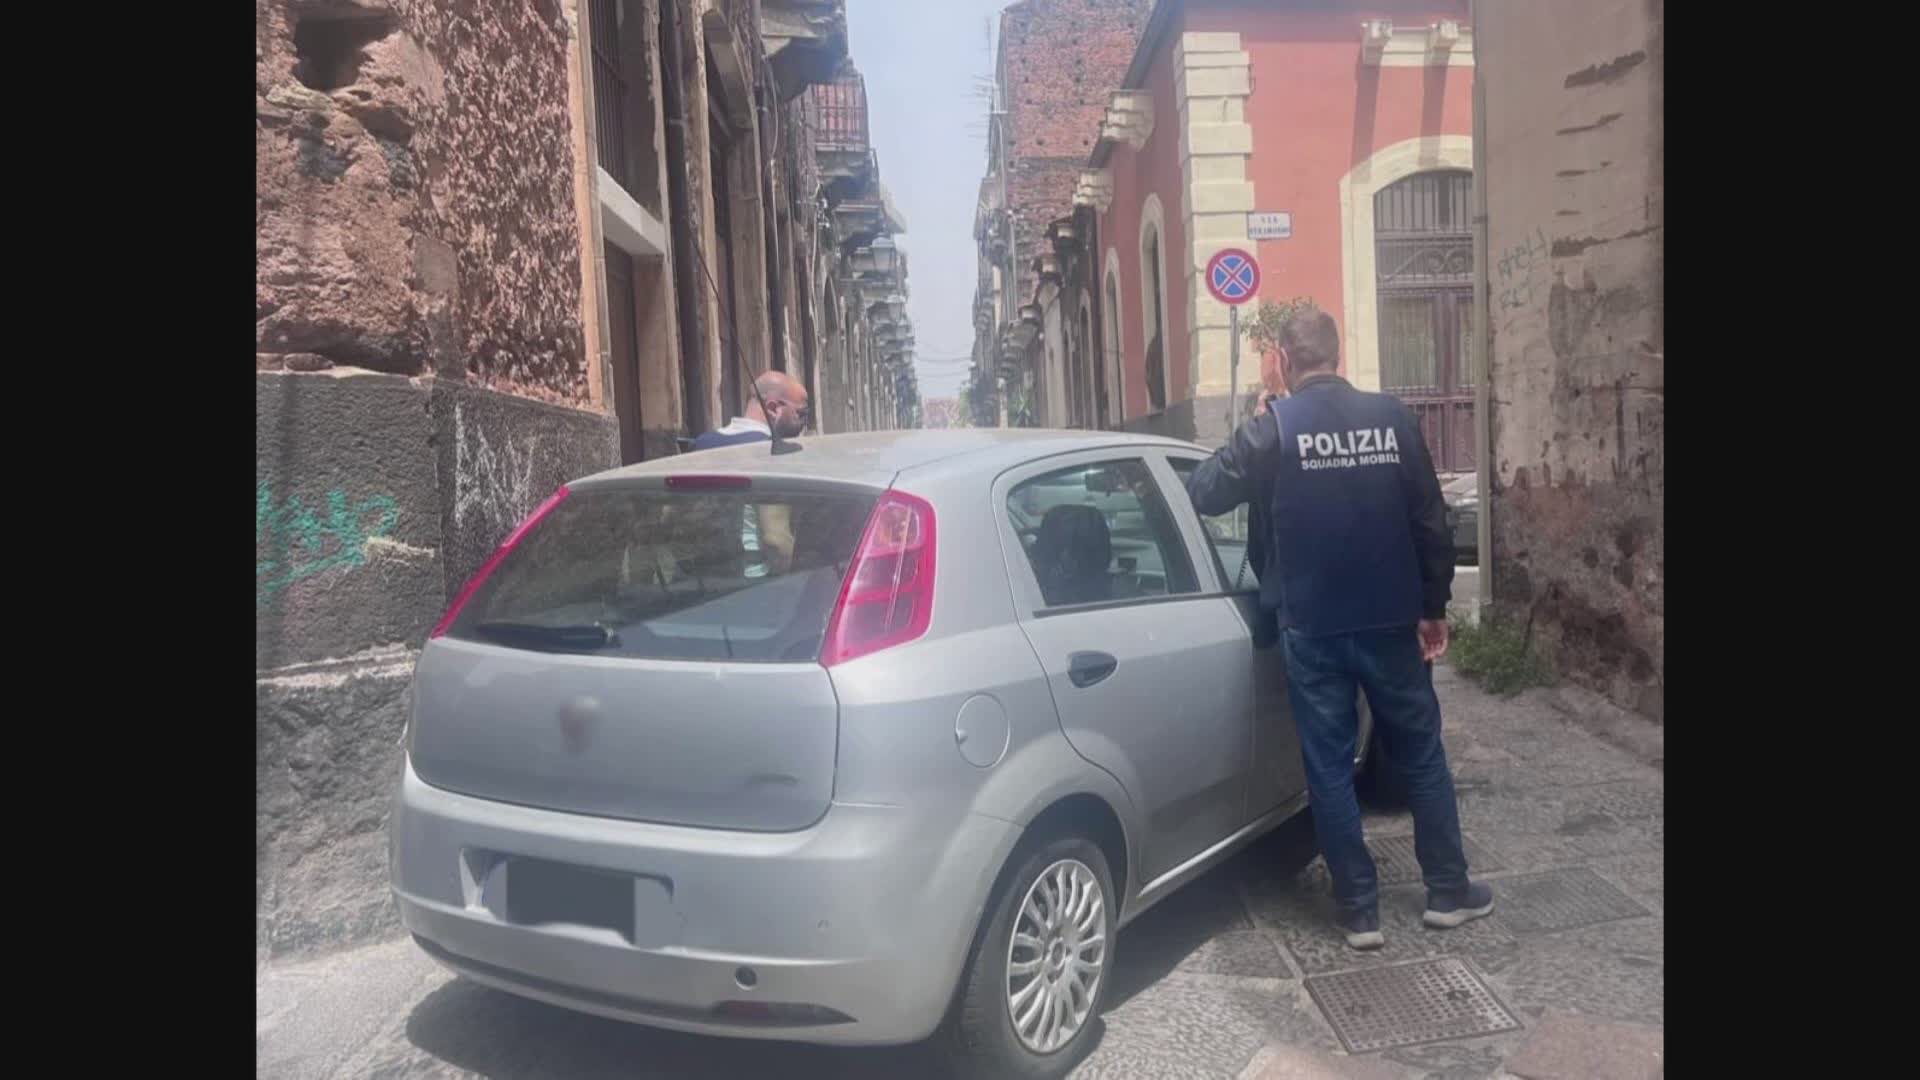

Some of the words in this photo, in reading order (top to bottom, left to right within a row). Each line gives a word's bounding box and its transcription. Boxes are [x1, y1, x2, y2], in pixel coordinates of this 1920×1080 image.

[1261, 215, 1279, 224] VIA
[1297, 427, 1399, 457] POLIZIA
[1302, 457, 1356, 470] SQUADRA
